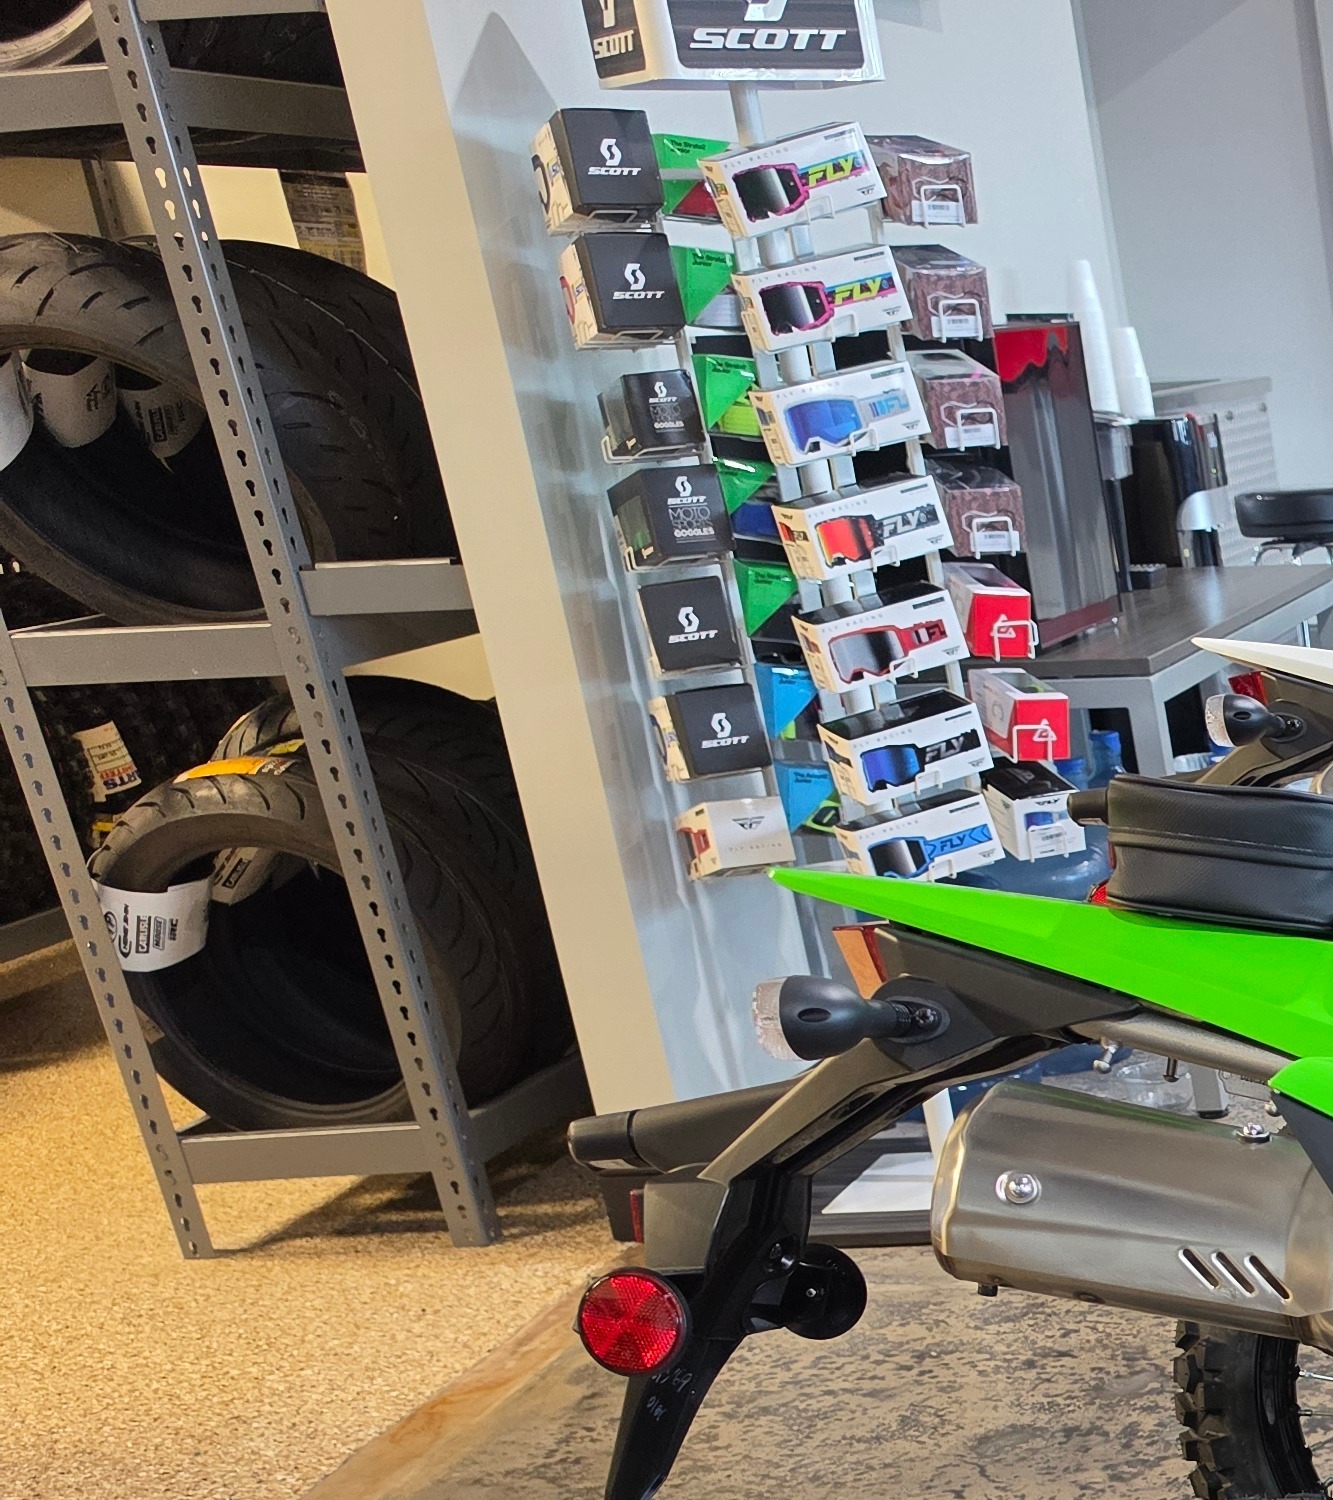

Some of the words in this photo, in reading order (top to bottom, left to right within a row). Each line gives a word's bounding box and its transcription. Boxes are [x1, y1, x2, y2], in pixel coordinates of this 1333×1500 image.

[593, 29, 635, 60] SCOTT
[689, 27, 847, 51] SCOTT
[587, 166, 642, 176] SCOTT
[808, 155, 854, 187] FLY
[612, 290, 665, 300] SCOTT
[834, 276, 882, 306] FLY
[667, 495, 707, 506] SCOTT
[882, 510, 921, 538] FLY
[668, 629, 719, 644] SCOTT
[701, 735, 750, 749] SCOTT
[924, 735, 965, 764] FLY
[939, 834, 967, 853] FLY
